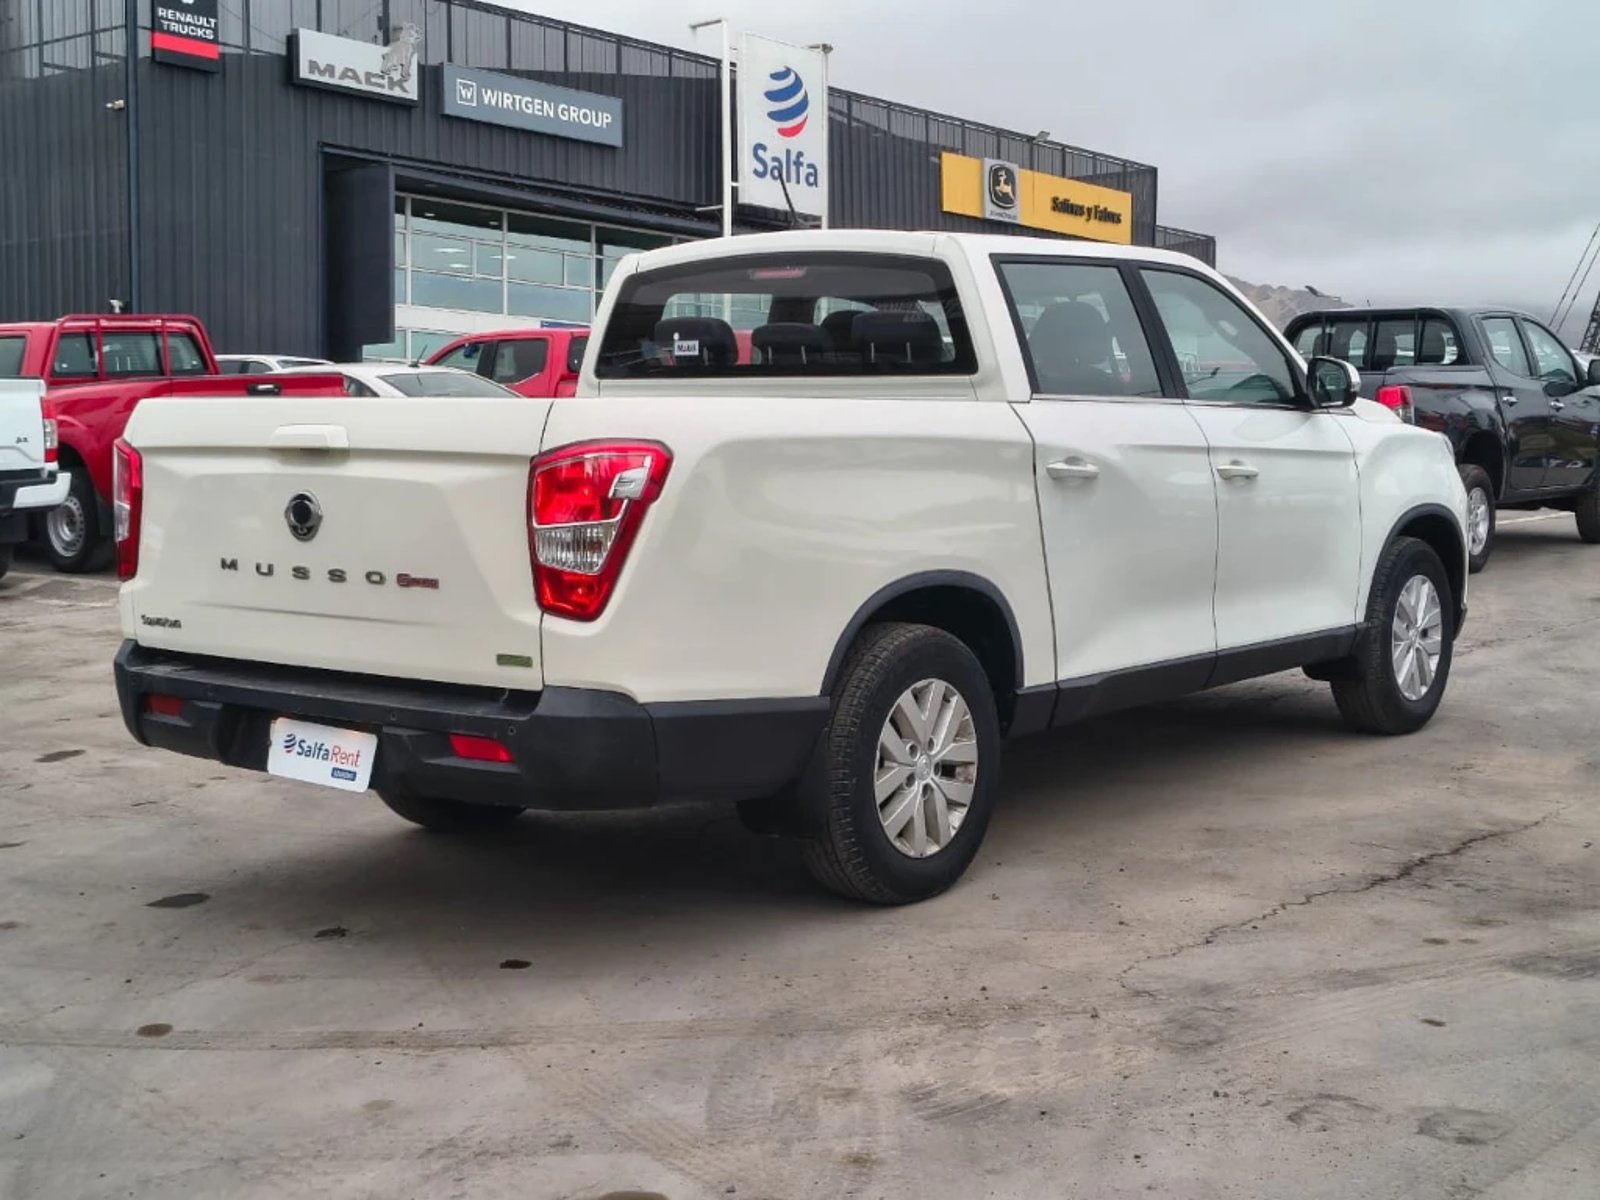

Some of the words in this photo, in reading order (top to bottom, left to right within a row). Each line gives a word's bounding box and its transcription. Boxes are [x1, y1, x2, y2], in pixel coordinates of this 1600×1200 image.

[158, 7, 216, 28] RENAULT
[161, 20, 214, 40] TRUCKS
[308, 59, 409, 93] MACK
[482, 88, 554, 118] WIRTGEN
[558, 104, 612, 128] GROUP
[753, 142, 818, 187] Salfa
[221, 558, 386, 581] MUSSO
